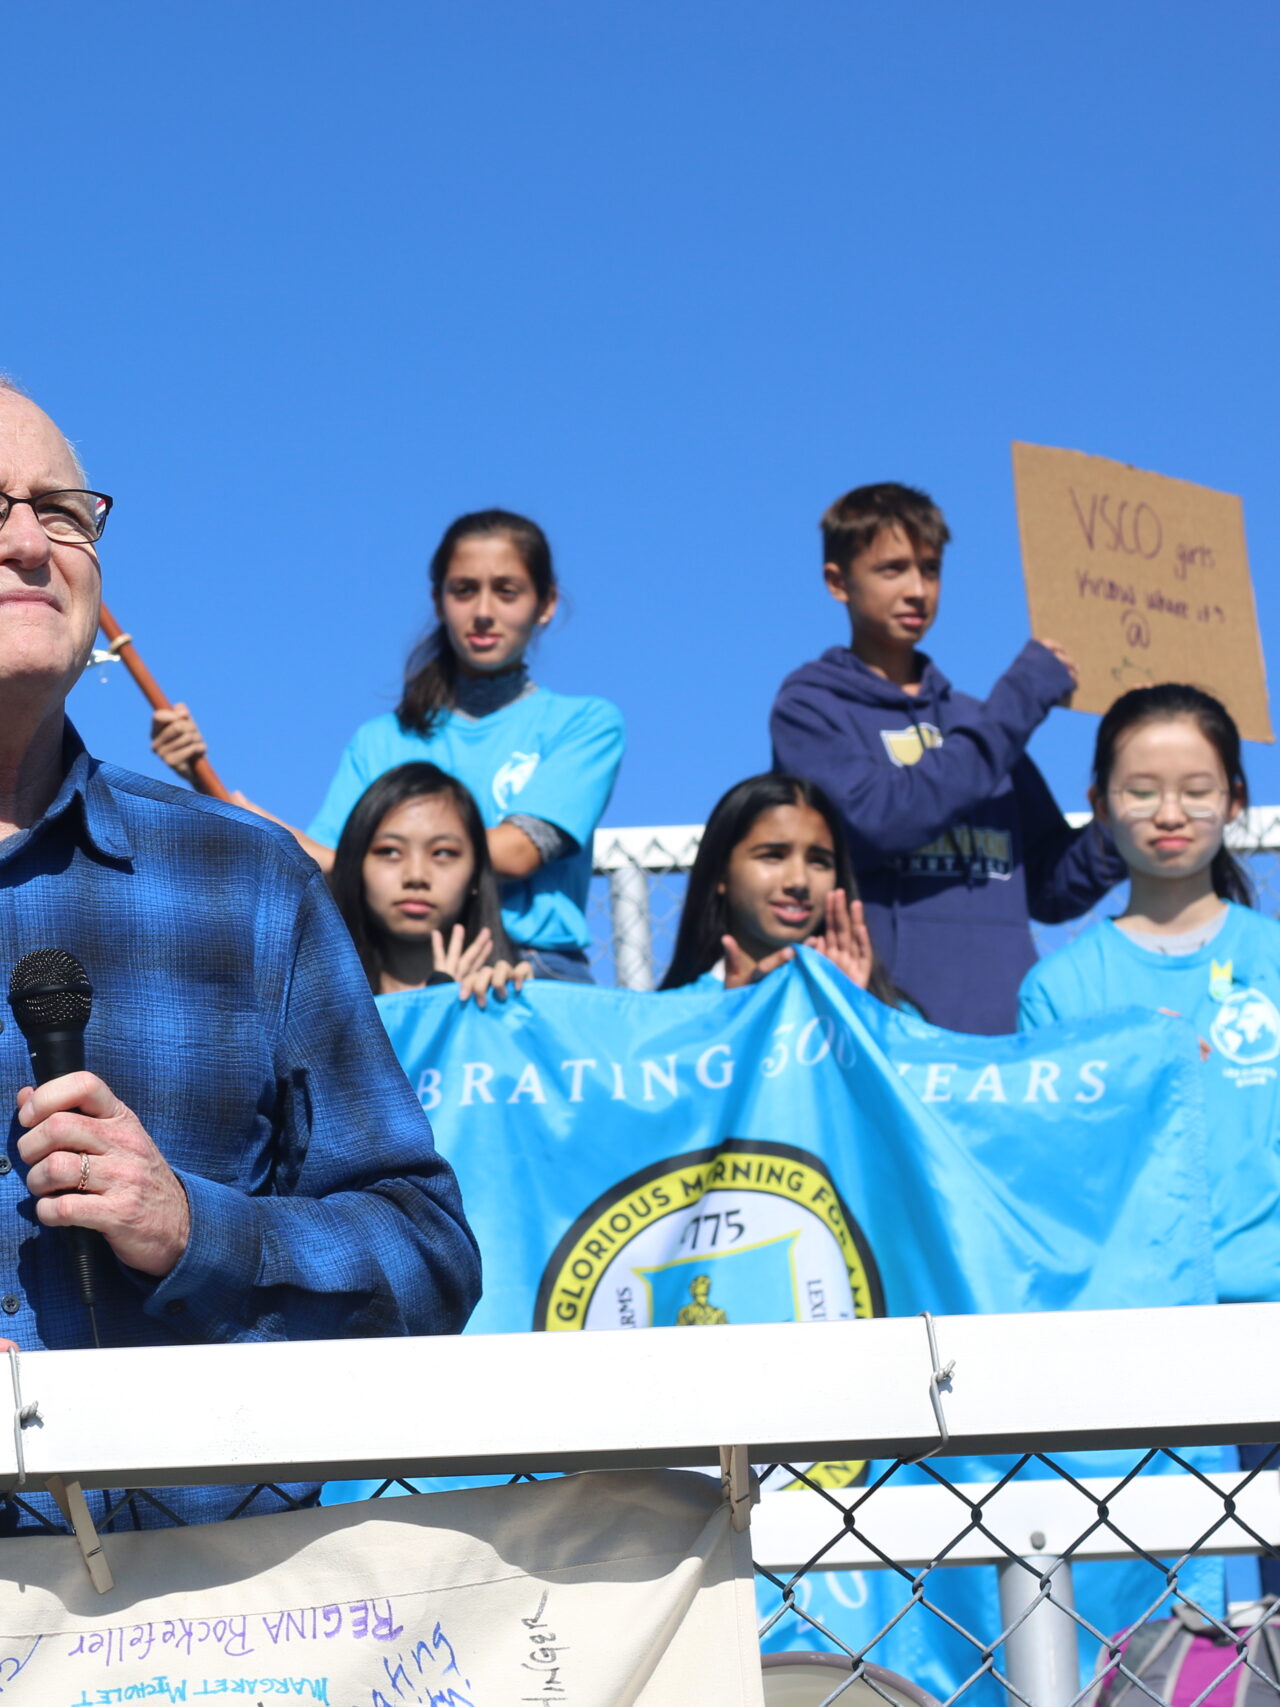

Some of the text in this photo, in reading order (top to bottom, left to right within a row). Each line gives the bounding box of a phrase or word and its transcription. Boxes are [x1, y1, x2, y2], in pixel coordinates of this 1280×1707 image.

[1068, 487, 1164, 560] VSCO
[896, 1060, 1108, 1103] EARS
[556, 1187, 671, 1321] GLORIOUS
[680, 1160, 806, 1198] MRNING
[67, 1600, 404, 1666] REGINA Rockefeller
[193, 1677, 332, 1707] MARGARET
